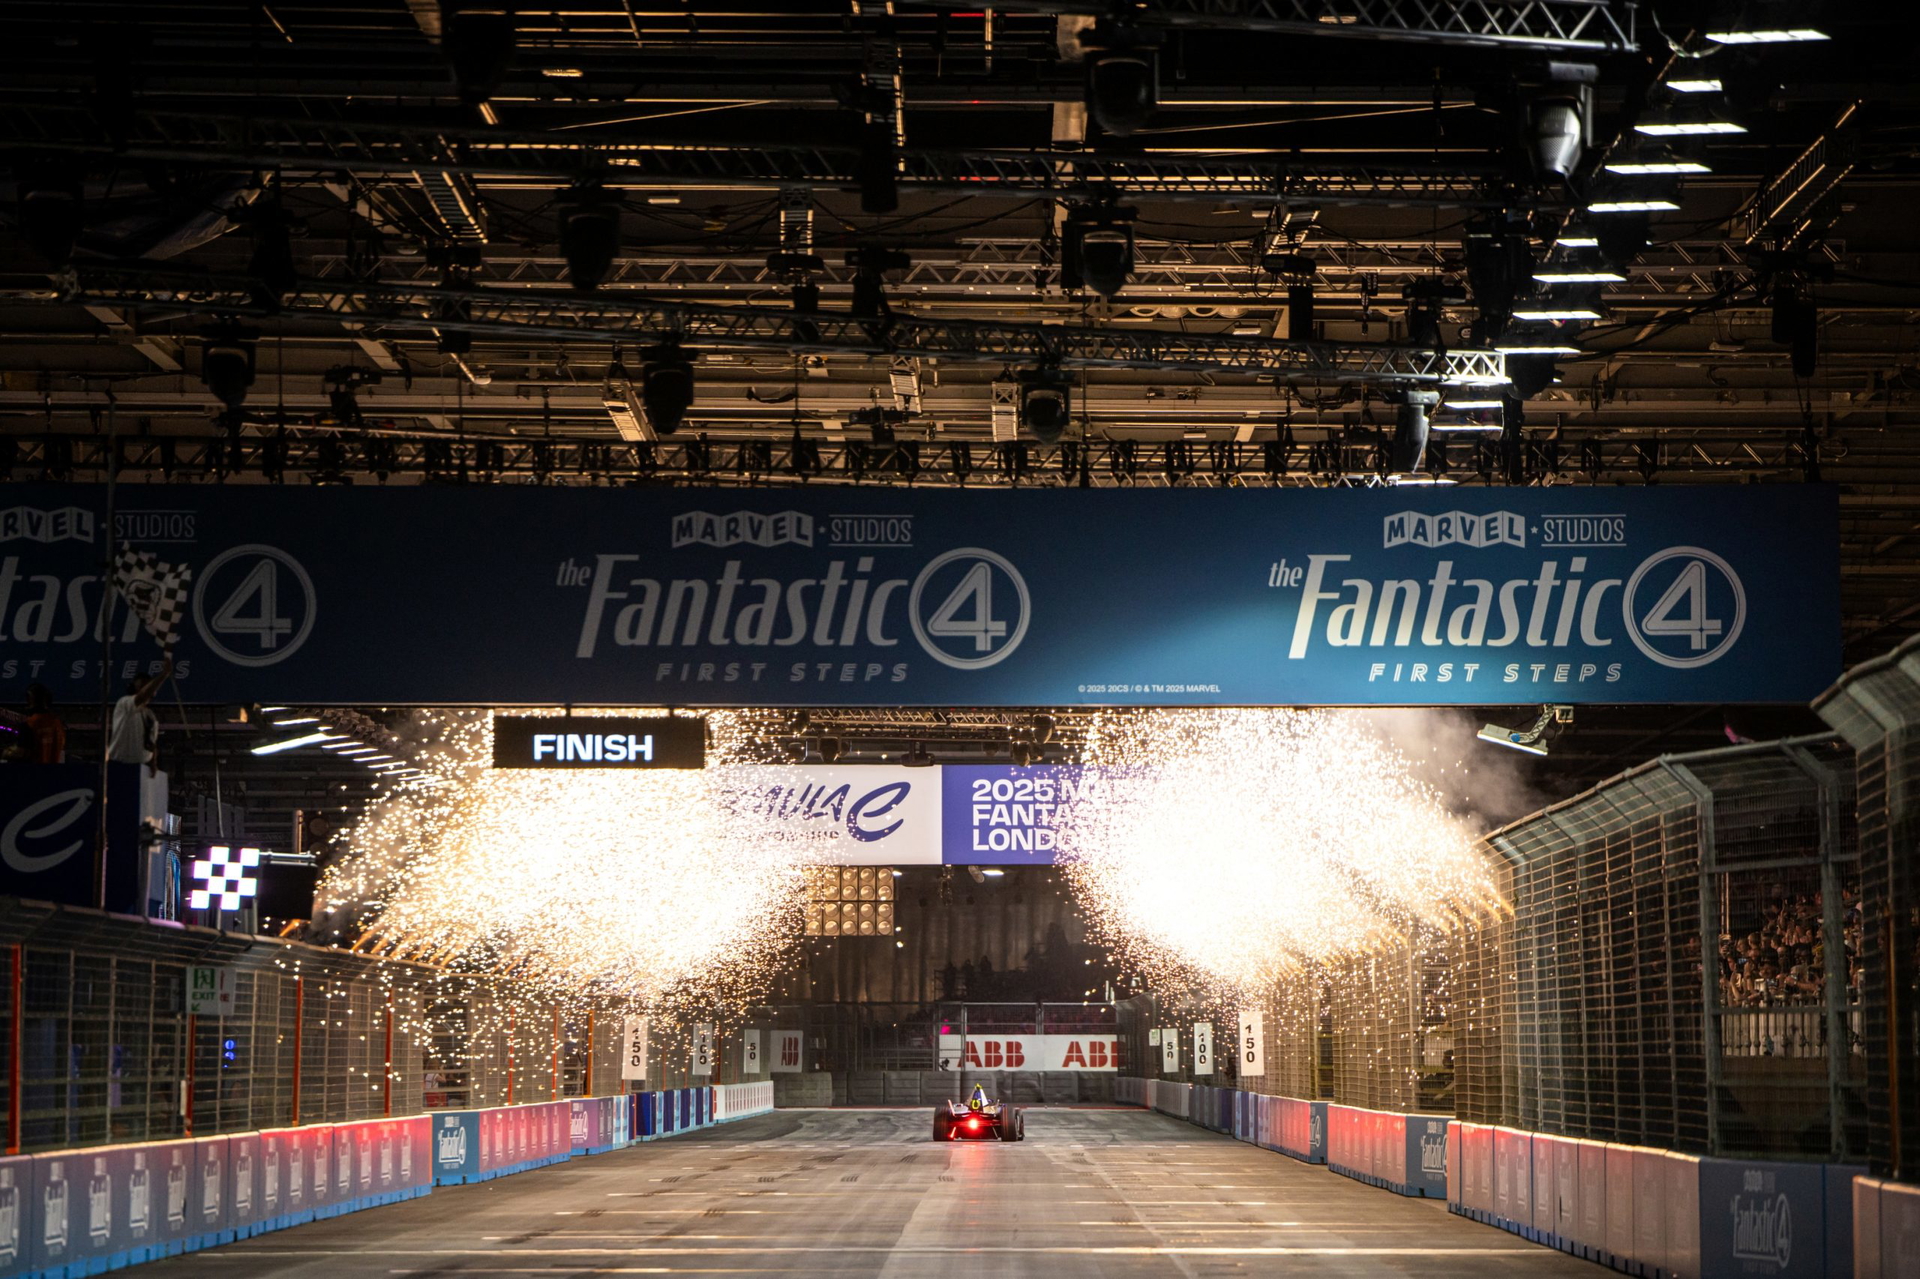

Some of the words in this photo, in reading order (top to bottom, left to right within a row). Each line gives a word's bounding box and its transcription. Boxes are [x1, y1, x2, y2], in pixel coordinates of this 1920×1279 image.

[114, 514, 196, 539] STUDIOS
[675, 515, 810, 542] MARVEL
[831, 518, 912, 543] STUDIOS
[1387, 515, 1521, 542] MARVEL
[1543, 518, 1625, 542] STUDIOS
[210, 557, 293, 650] 4
[556, 558, 591, 587] the
[575, 554, 909, 658] Fantastic
[925, 560, 1008, 653] 4
[1268, 558, 1303, 587] the
[1288, 554, 1623, 659] Fantastic
[1639, 558, 1723, 652] 4
[655, 662, 767, 682] FIRST
[789, 662, 908, 682] STEPS
[1368, 663, 1480, 683] FIRST
[1503, 663, 1622, 683] STEPS
[1087, 684, 1106, 693] 2025
[1143, 684, 1150, 693] &
[1152, 684, 1164, 693] TM
[1165, 684, 1185, 693] 2025
[1186, 684, 1221, 693] MARVEL
[533, 734, 653, 761] FINISH
[972, 779, 1054, 801] 2025
[191, 991, 216, 1001] EXIT
[631, 1027, 641, 1066] 150
[750, 1043, 756, 1060] 50
[780, 1036, 799, 1066] ABB
[956, 1040, 1026, 1068] ABB
[1198, 1033, 1207, 1064] 100
[1245, 1024, 1255, 1063] 150
